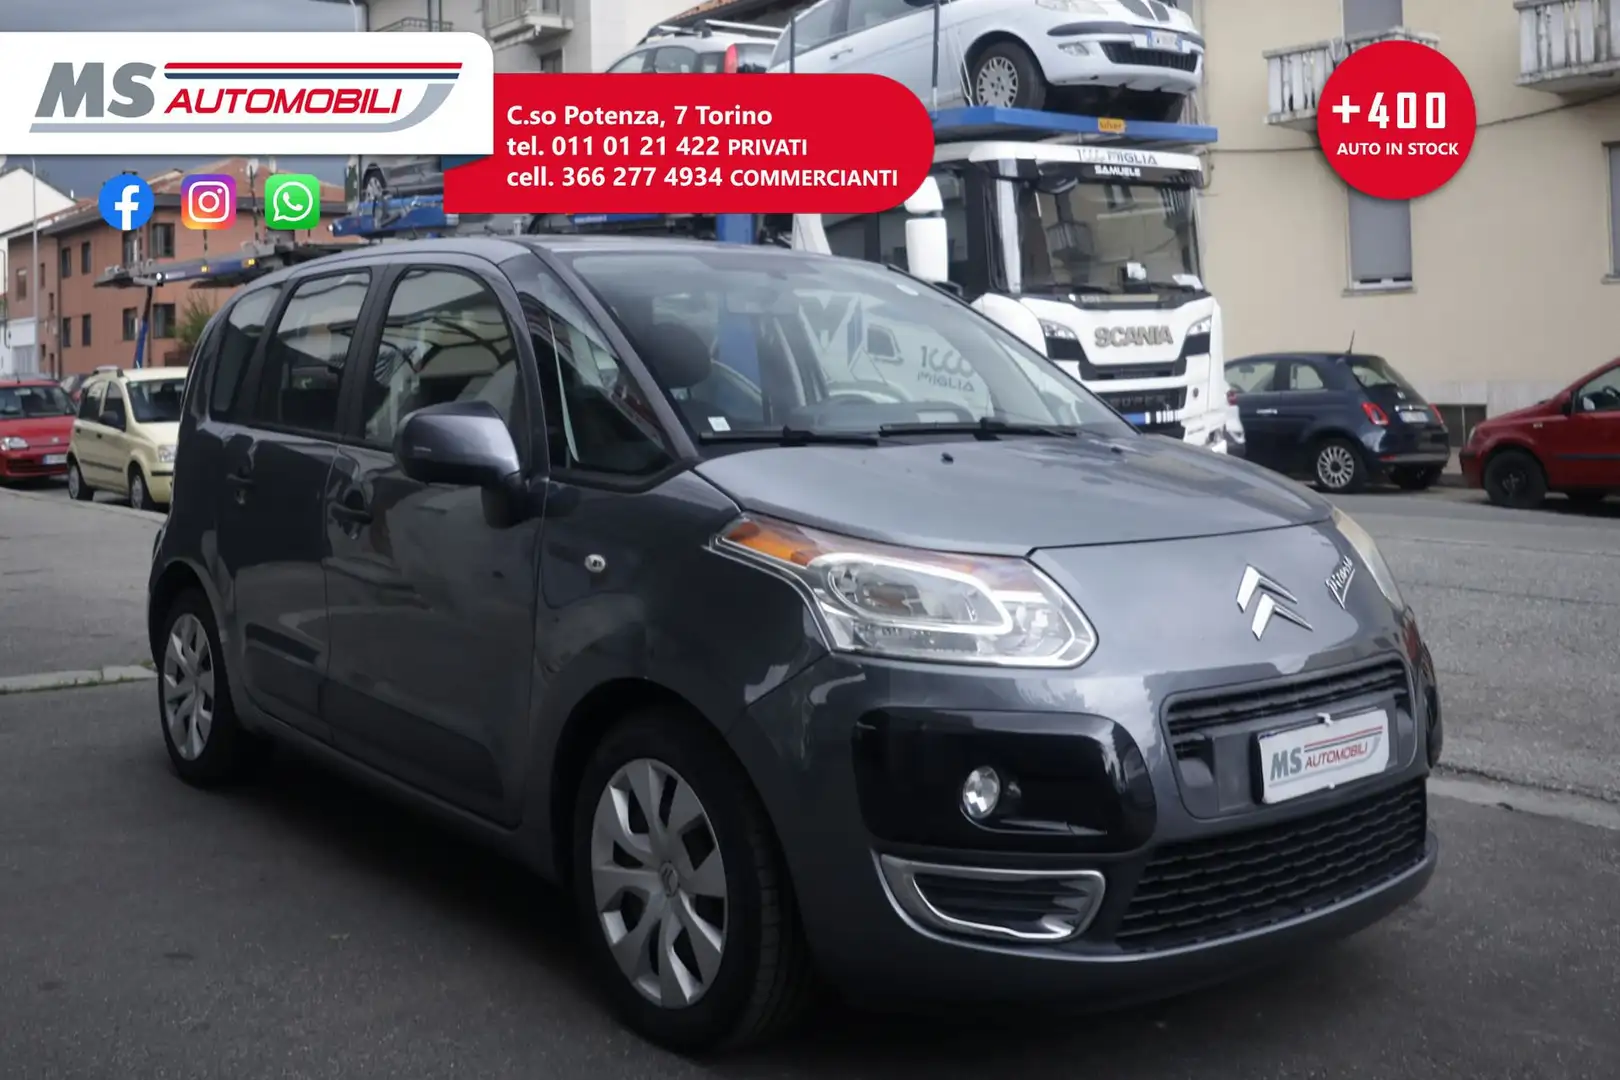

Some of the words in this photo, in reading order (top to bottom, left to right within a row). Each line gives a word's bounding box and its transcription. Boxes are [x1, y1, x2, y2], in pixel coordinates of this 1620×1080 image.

[1106, 151, 1158, 165] MIGLIA
[1094, 325, 1174, 348] SCANIA
[916, 371, 976, 392] MIGLIA
[1270, 747, 1302, 781] MS
[1305, 741, 1368, 769] AUTOMOBILI
